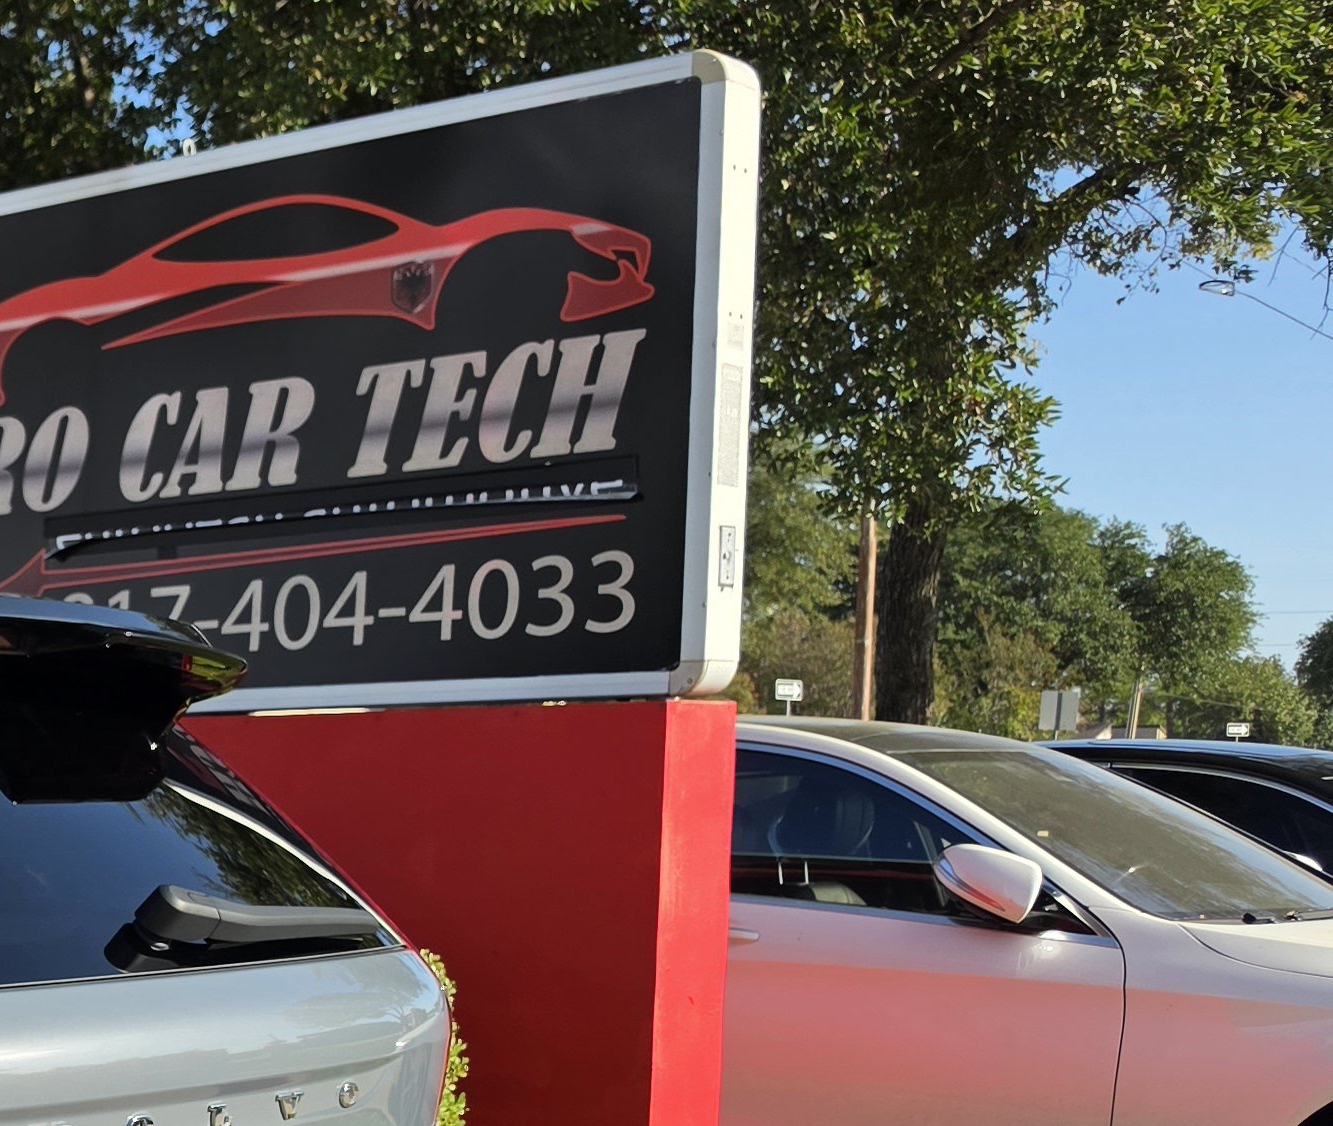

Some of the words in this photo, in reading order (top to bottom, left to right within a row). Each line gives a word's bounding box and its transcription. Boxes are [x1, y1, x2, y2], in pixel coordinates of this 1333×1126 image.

[118, 376, 316, 504] CAR
[347, 328, 646, 479] TECH
[64, 549, 636, 652] 7-404-4033
